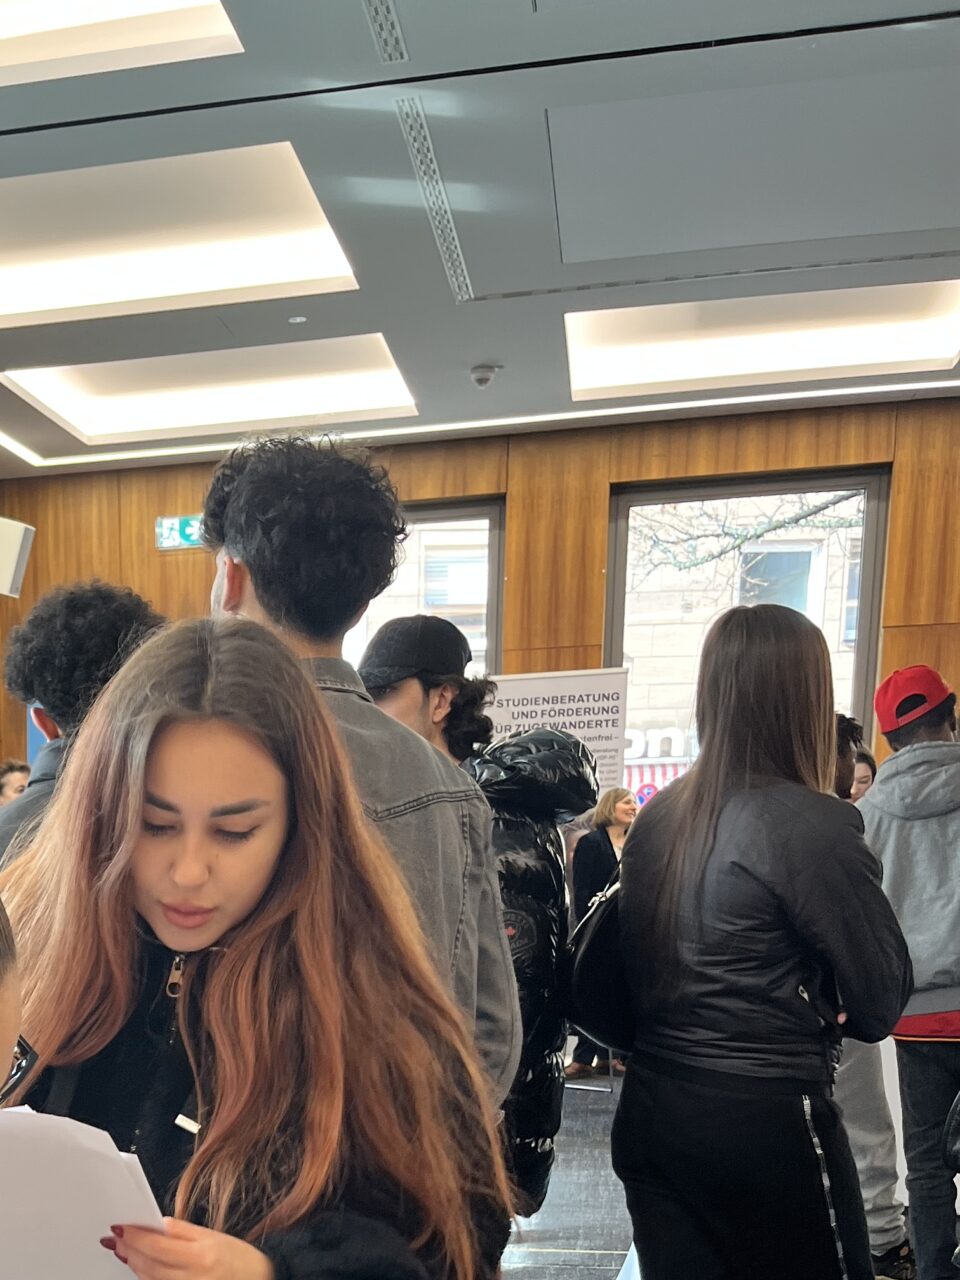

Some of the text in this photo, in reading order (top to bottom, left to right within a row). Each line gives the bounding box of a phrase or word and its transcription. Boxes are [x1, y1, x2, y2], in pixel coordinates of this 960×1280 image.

[496, 691, 620, 708] STUDIENBERATUNG
[512, 705, 620, 720] UND FÖRDERUNG
[495, 723, 512, 734] ÜR
